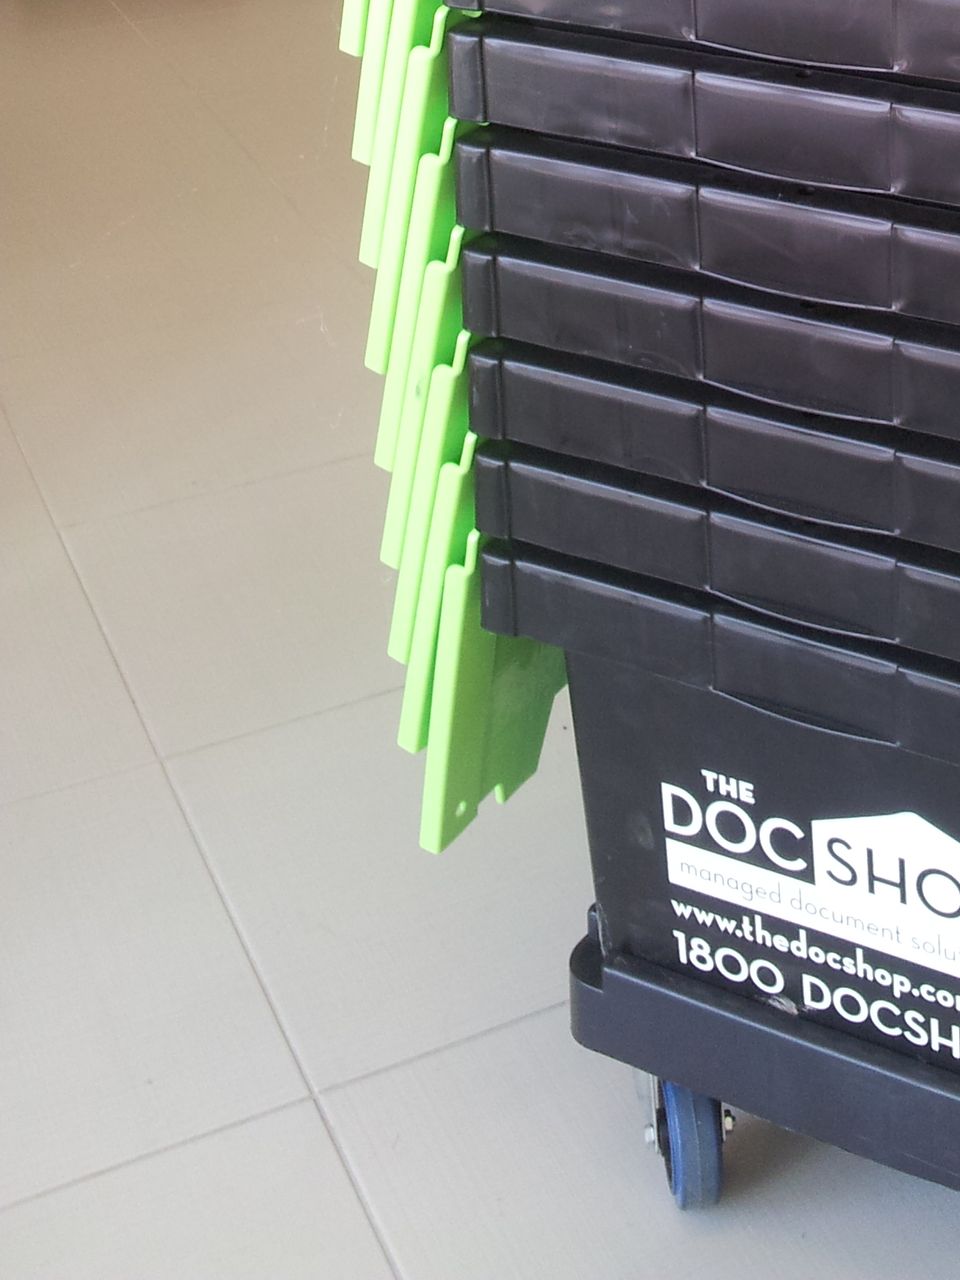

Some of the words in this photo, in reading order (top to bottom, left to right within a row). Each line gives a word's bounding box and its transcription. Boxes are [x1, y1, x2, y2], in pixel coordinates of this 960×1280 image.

[700, 769, 756, 805] THE
[680, 860, 782, 902] managed
[790, 888, 901, 944] document
[672, 930, 785, 995] 1800
